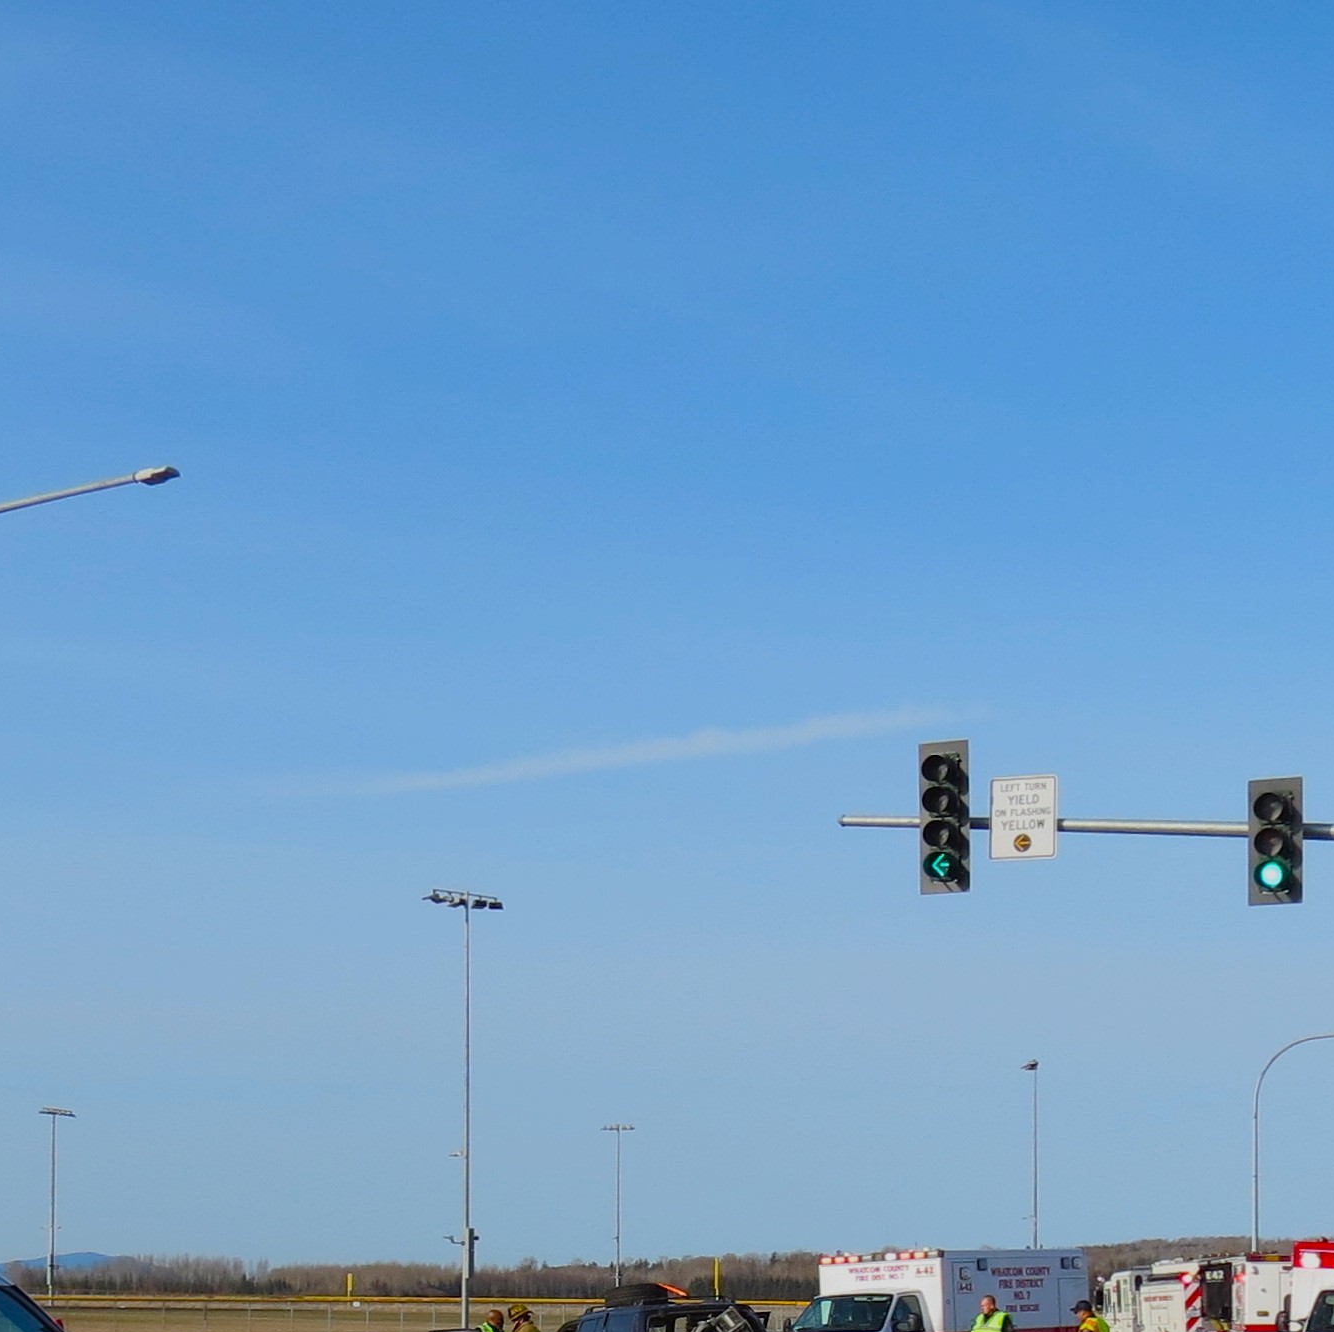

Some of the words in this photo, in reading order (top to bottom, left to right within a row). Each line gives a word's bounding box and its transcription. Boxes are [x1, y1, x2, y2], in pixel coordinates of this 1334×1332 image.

[1000, 784, 1020, 792] LEFT
[1024, 782, 1047, 790] TURN
[1008, 794, 1039, 805] YIELD
[1011, 806, 1051, 816] FLASHING
[1001, 819, 1045, 831] YELLOW
